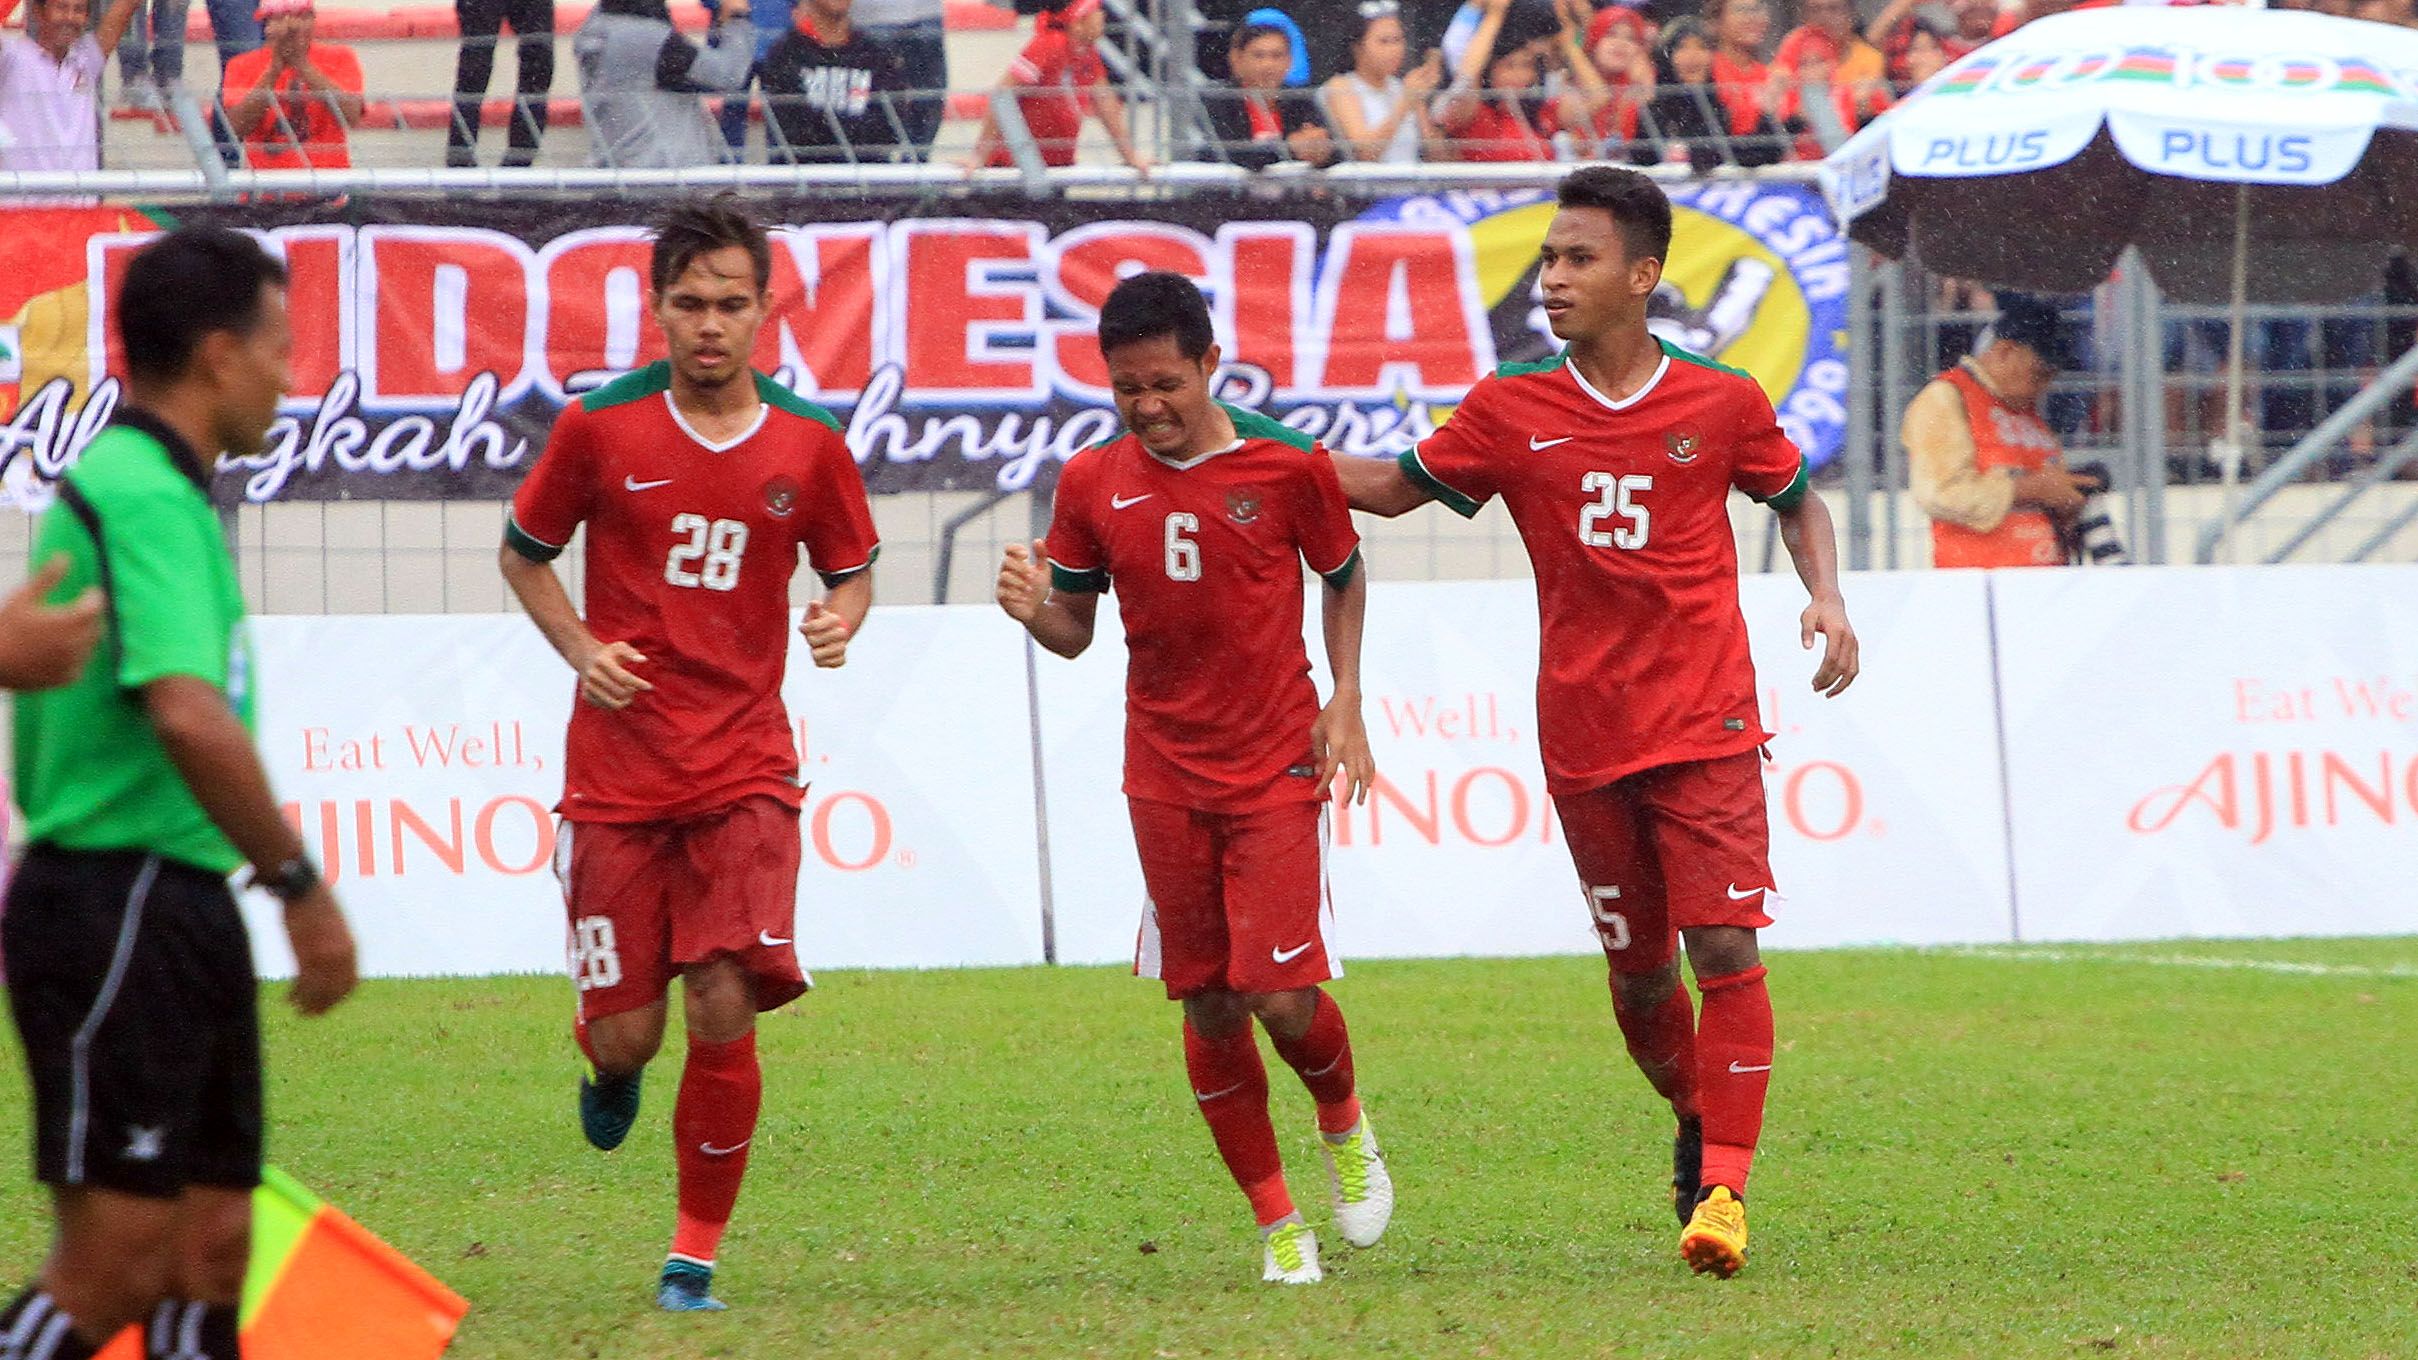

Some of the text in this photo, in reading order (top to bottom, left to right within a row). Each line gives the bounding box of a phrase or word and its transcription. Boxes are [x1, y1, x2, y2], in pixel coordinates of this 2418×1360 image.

[1923, 129, 2050, 168] PLUS
[2161, 129, 2312, 173] PLUS
[0, 375, 527, 501] Algkah
[1578, 471, 1653, 550] 25
[664, 512, 749, 592] 28
[1165, 512, 1201, 581] 6
[1380, 692, 1519, 744] Well,
[2340, 675, 2418, 723] We
[303, 720, 544, 771] Eat Well,
[2126, 751, 2418, 846] AJIN
[1582, 882, 1631, 950] 5
